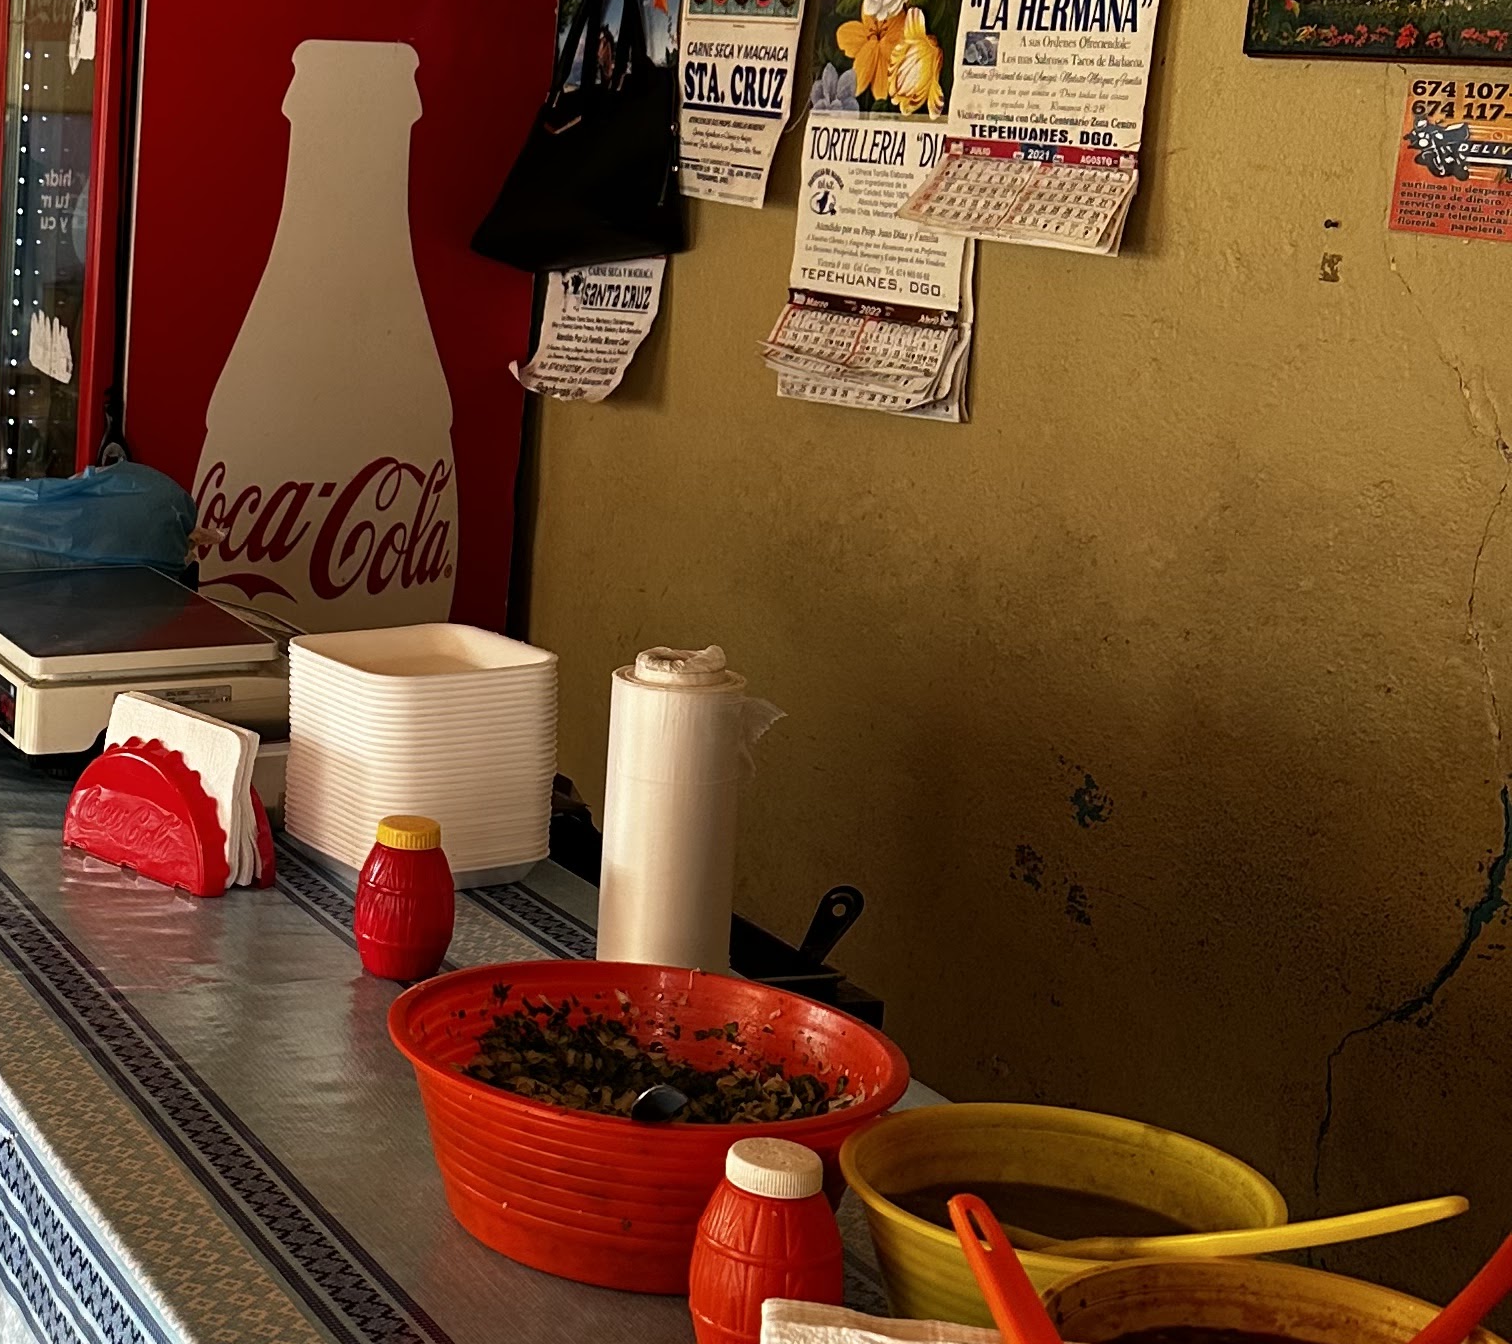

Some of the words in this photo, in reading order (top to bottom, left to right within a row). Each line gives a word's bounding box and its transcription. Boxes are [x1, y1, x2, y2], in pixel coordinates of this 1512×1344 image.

[687, 41, 714, 57] CARNE
[715, 43, 735, 59] SECA
[738, 44, 743, 59] Y
[743, 45, 789, 62] MACHACA
[684, 60, 725, 104] STA.
[730, 64, 788, 110] CRUZ
[1412, 80, 1456, 98] 674
[1412, 100, 1455, 119] 674
[810, 126, 906, 166] TORTILLERIA
[1080, 131, 1117, 147] DGO.
[1028, 149, 1050, 160] 2021
[1080, 156, 1112, 166] AGOSTO
[1401, 181, 1448, 191] surtimos
[1400, 190, 1446, 203] entregas
[1449, 193, 1463, 202] de
[1398, 208, 1445, 220] recargas
[1399, 200, 1441, 210] servicio
[1443, 202, 1456, 211] de
[801, 267, 902, 293] TEPEHUANES,
[194, 456, 453, 604] Coca-Cola
